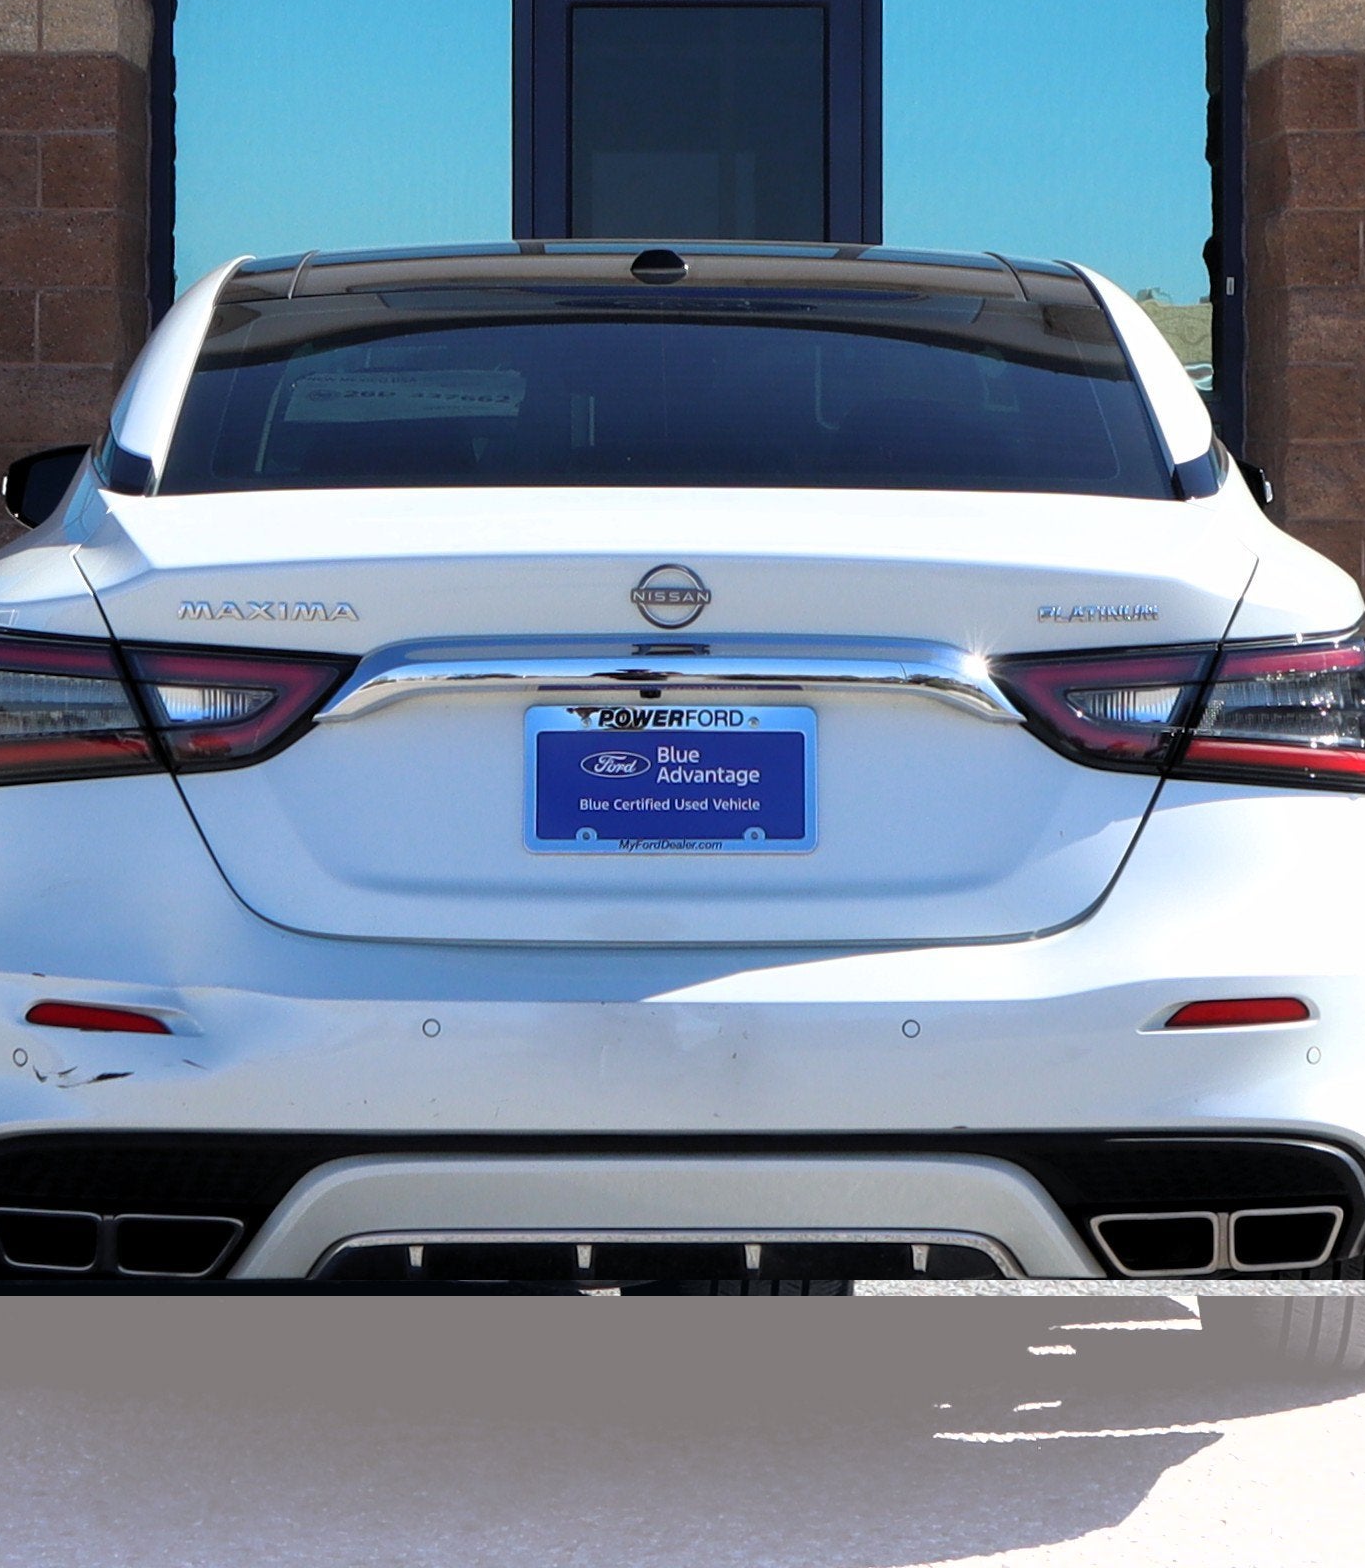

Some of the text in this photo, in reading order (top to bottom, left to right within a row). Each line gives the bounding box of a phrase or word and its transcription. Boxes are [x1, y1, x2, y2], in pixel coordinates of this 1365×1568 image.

[632, 591, 709, 602] NISSAN
[177, 600, 360, 622] MAXIMA
[598, 708, 745, 728] POWERFORD
[593, 753, 637, 774] Ford
[656, 745, 701, 764] Blue
[656, 765, 761, 787] Advantage
[579, 797, 761, 811] Blue Certified Used Vehicle
[618, 838, 723, 853] MyFordDealer.com
